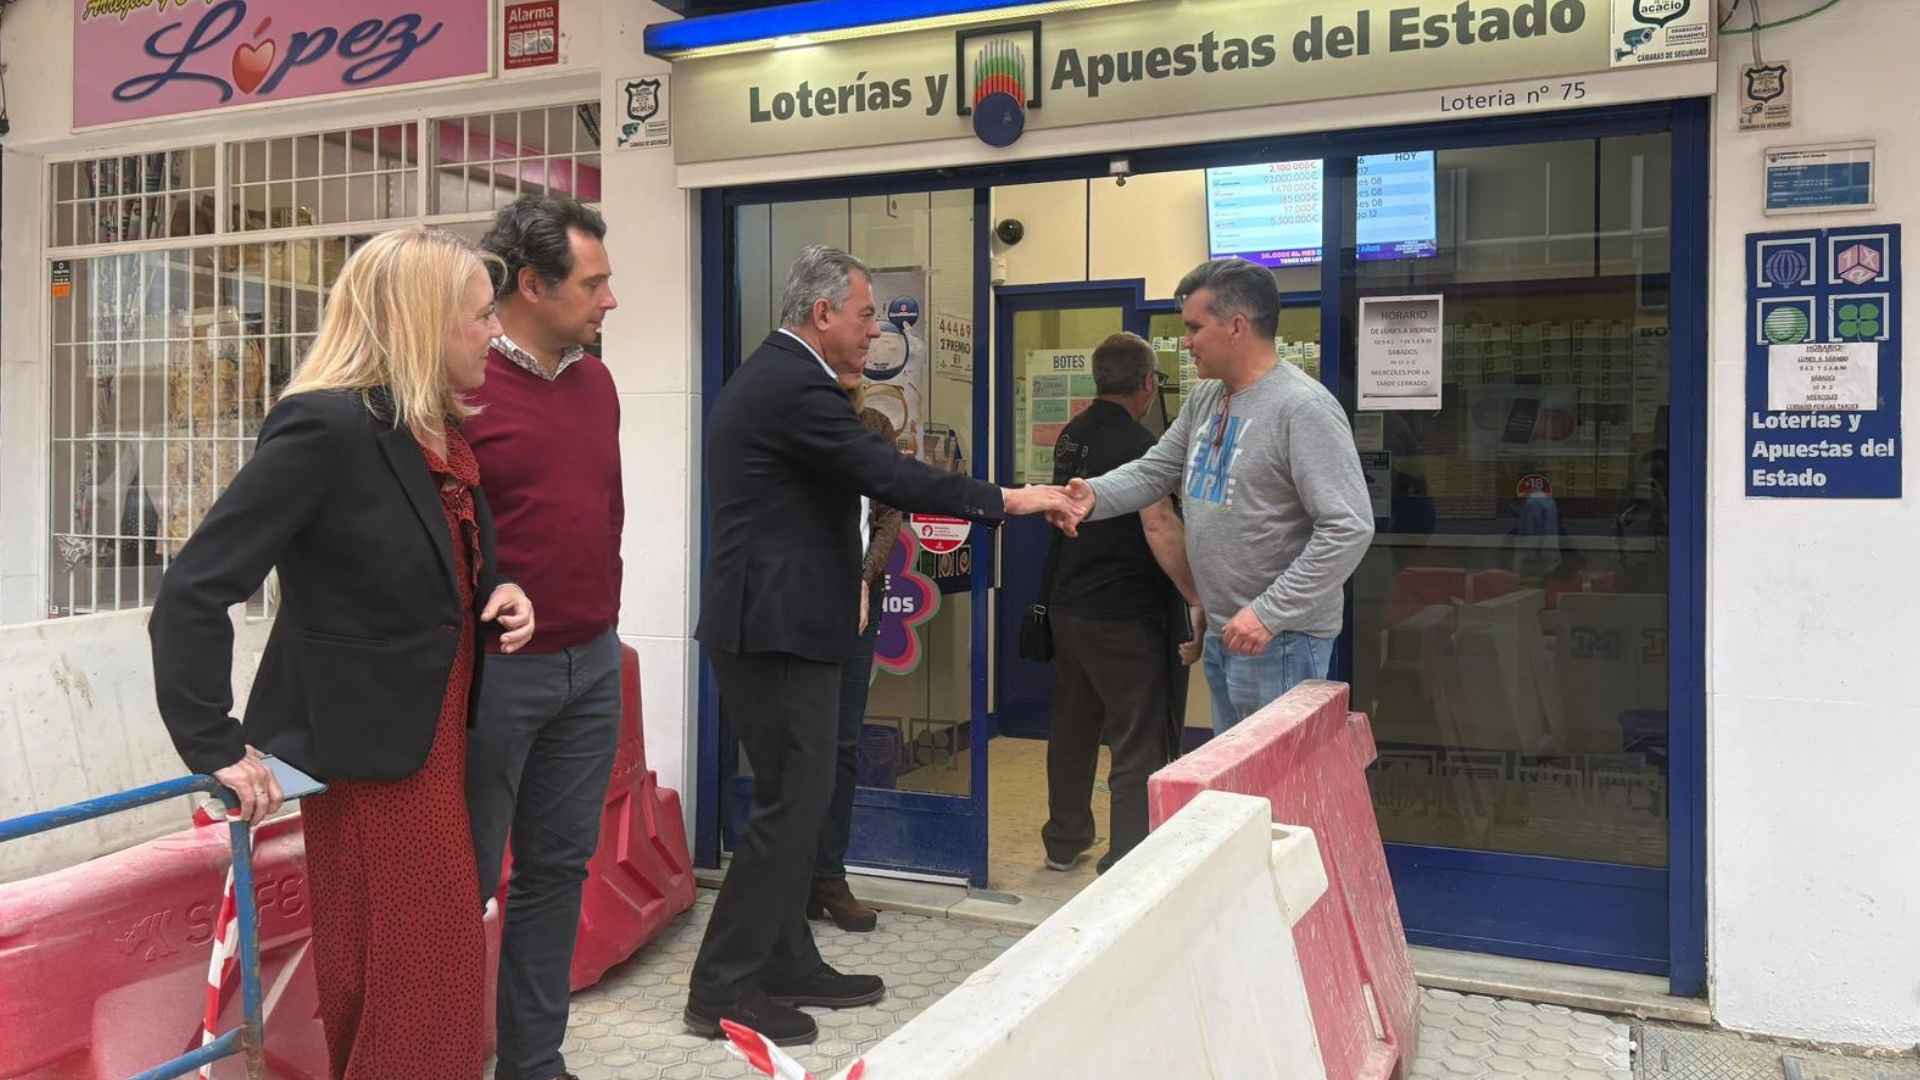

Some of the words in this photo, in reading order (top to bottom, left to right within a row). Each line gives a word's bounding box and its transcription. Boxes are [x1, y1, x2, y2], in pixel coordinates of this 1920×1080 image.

[509, 6, 554, 23] Alarma
[1641, 2, 1681, 13] acacio
[750, 71, 912, 123] Loterías
[924, 74, 949, 116] y
[1050, 31, 1276, 98] Apuestas
[1293, 9, 1370, 62] del
[1389, 0, 1586, 52] Estado
[1441, 90, 1515, 112] Loteria
[1561, 81, 1586, 101] 75
[1394, 152, 1417, 161] HOY
[1381, 311, 1428, 320] HORARIO
[1806, 344, 1841, 352] HORARIO
[1053, 354, 1086, 369] BOTES
[1752, 411, 1841, 429] Loterías
[1848, 413, 1862, 432] y
[1752, 440, 1854, 462] Apuestas
[1860, 438, 1895, 457] del
[1752, 468, 1827, 486] Estado
